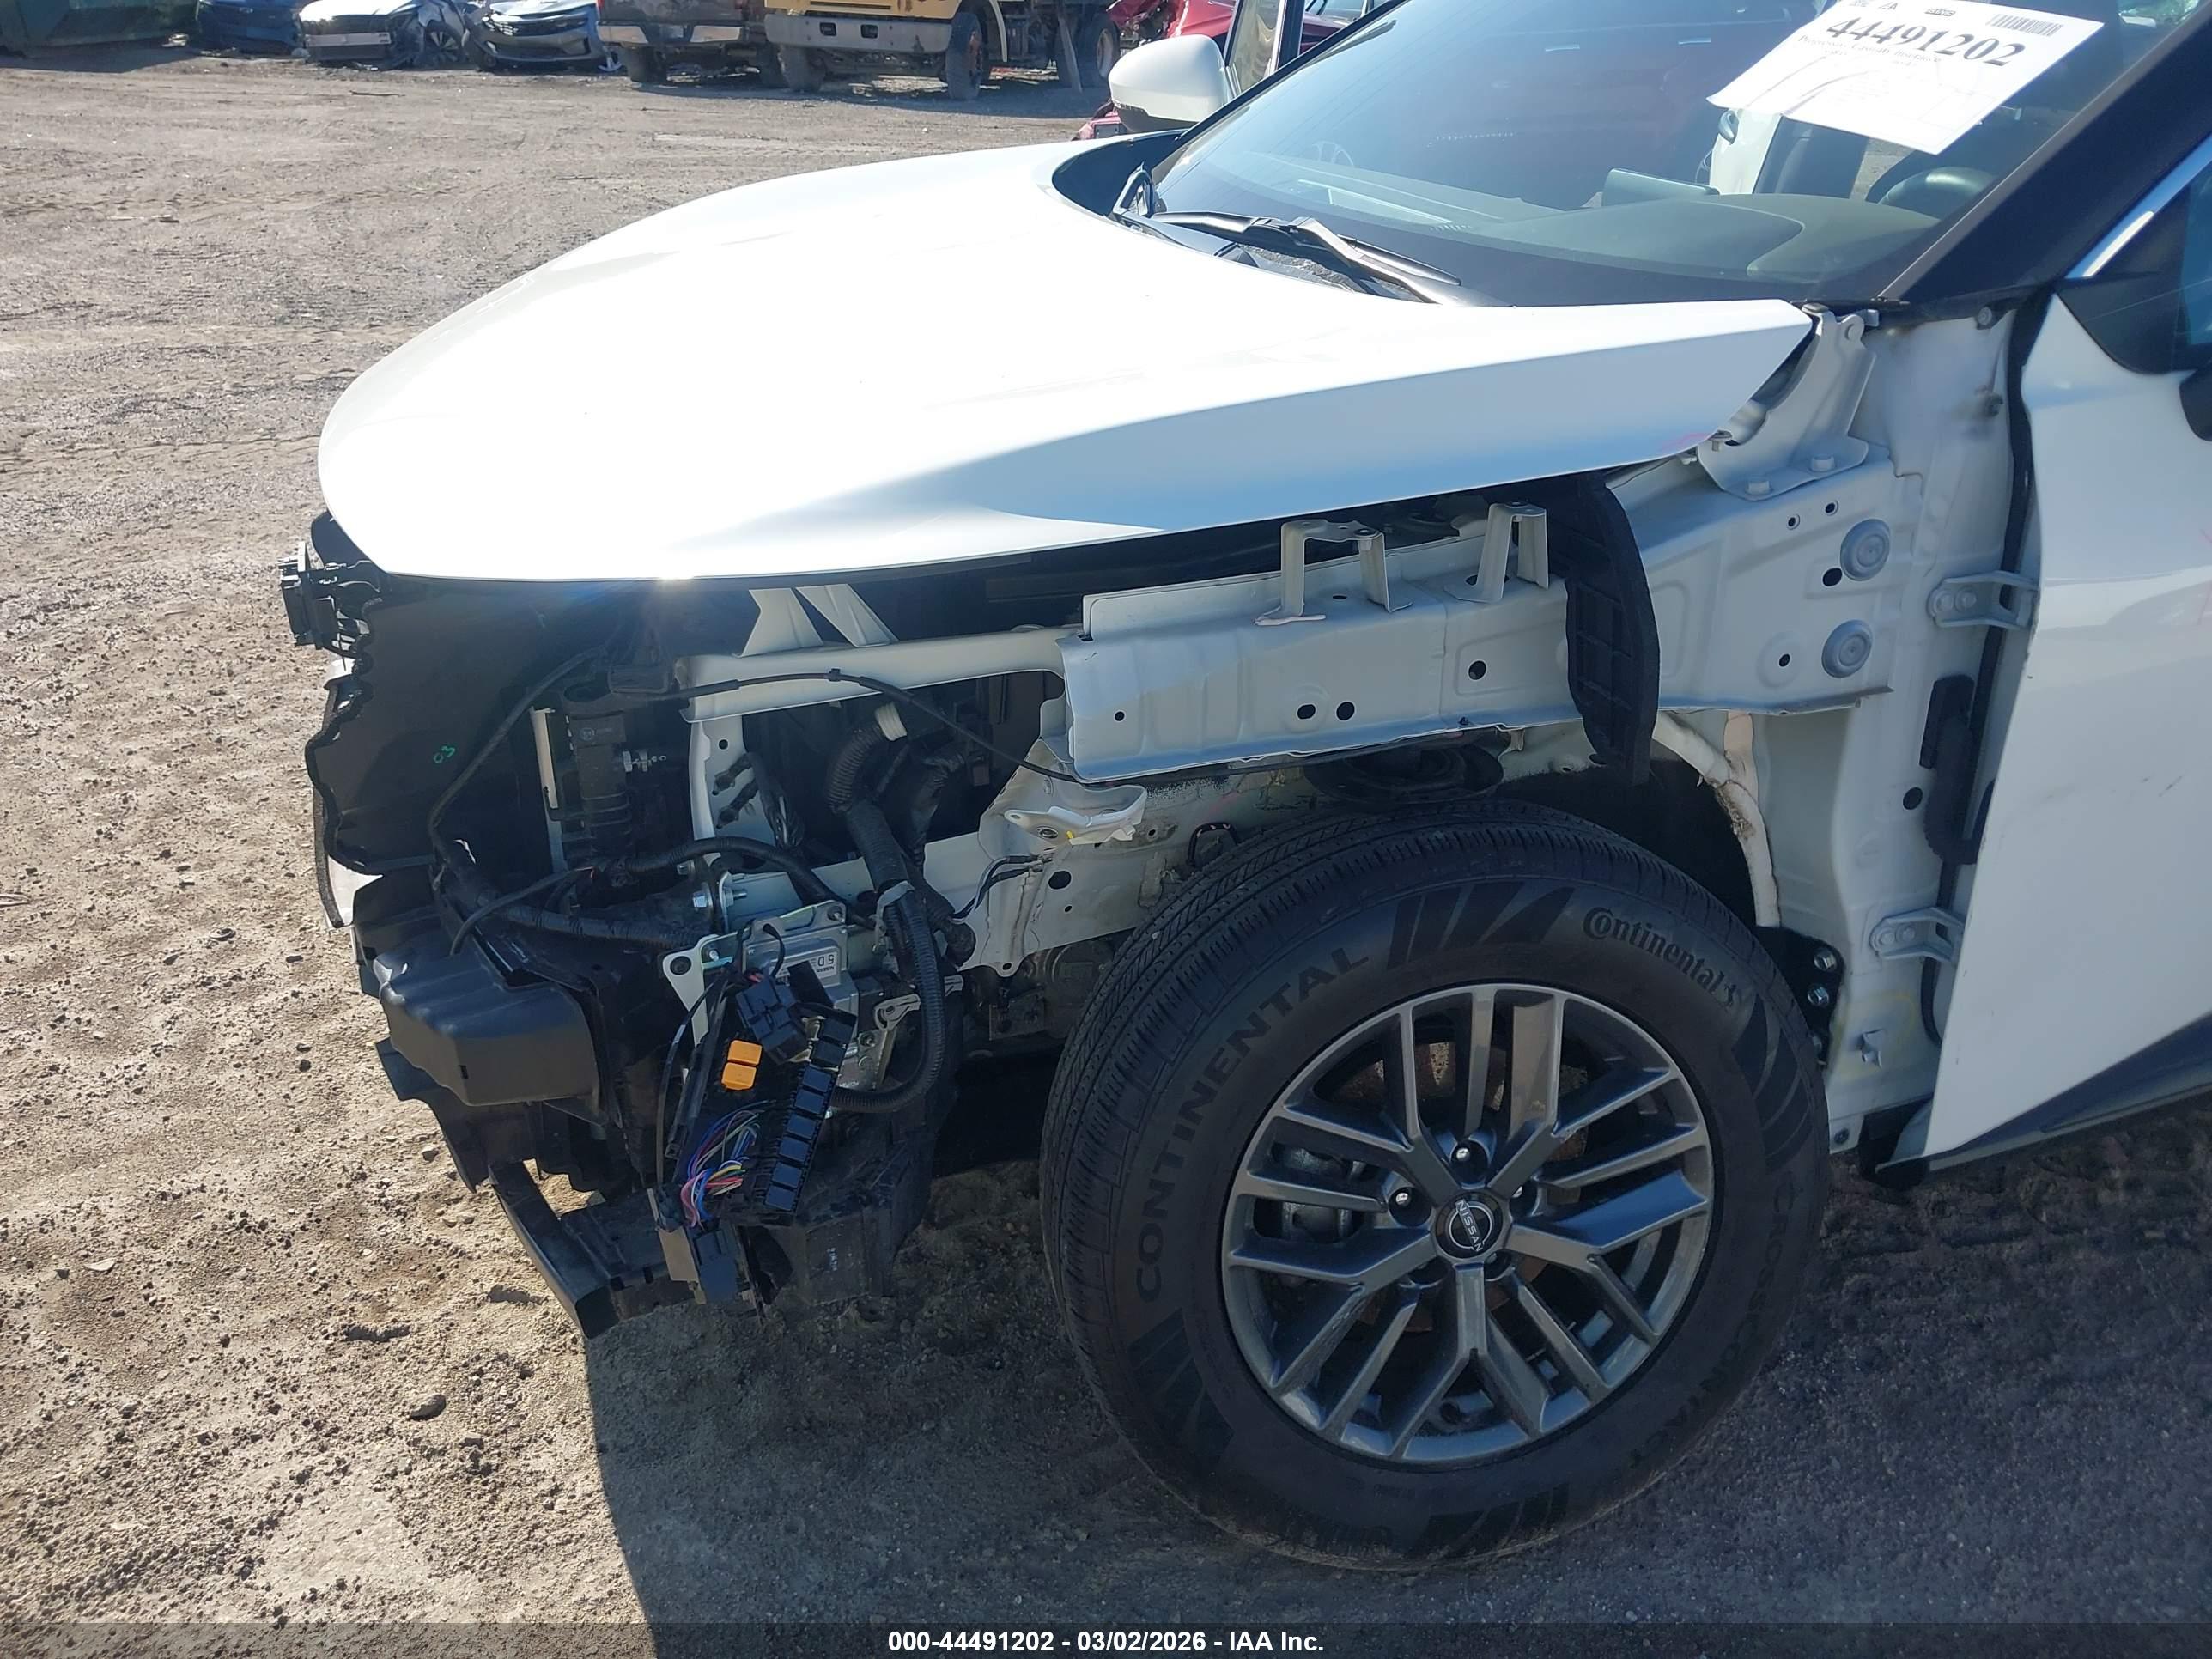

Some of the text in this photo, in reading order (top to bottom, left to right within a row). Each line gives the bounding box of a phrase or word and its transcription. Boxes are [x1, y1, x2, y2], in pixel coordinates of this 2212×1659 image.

[1826, 17, 2026, 67] 44491202
[1583, 907, 1725, 996] Continental
[1135, 947, 1370, 1304] CONTINENTAL
[1456, 1199, 1484, 1252] NISSAN
